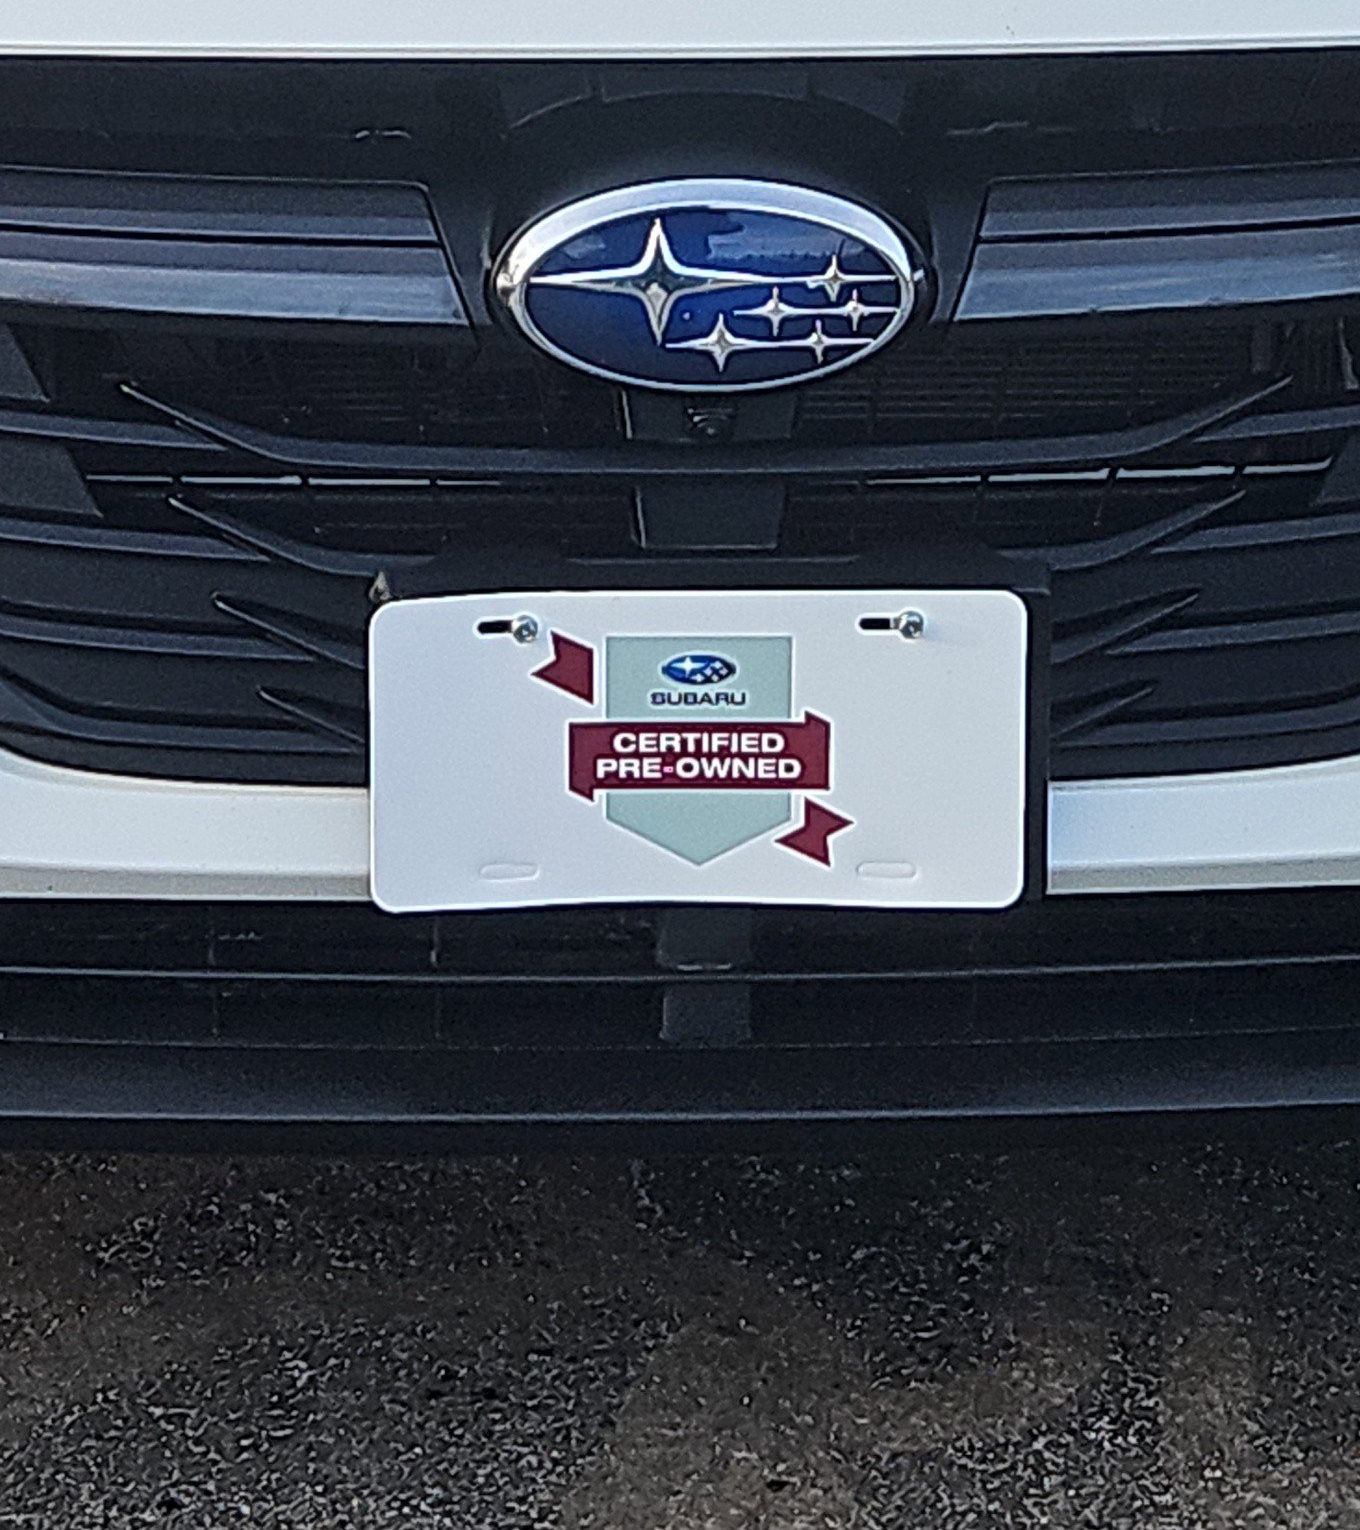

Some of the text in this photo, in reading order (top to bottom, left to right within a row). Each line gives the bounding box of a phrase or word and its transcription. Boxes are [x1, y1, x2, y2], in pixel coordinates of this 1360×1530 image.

[650, 691, 746, 706] SUBARU
[613, 732, 785, 754] CERTIFIED
[596, 757, 802, 780] PRE-OWNED
